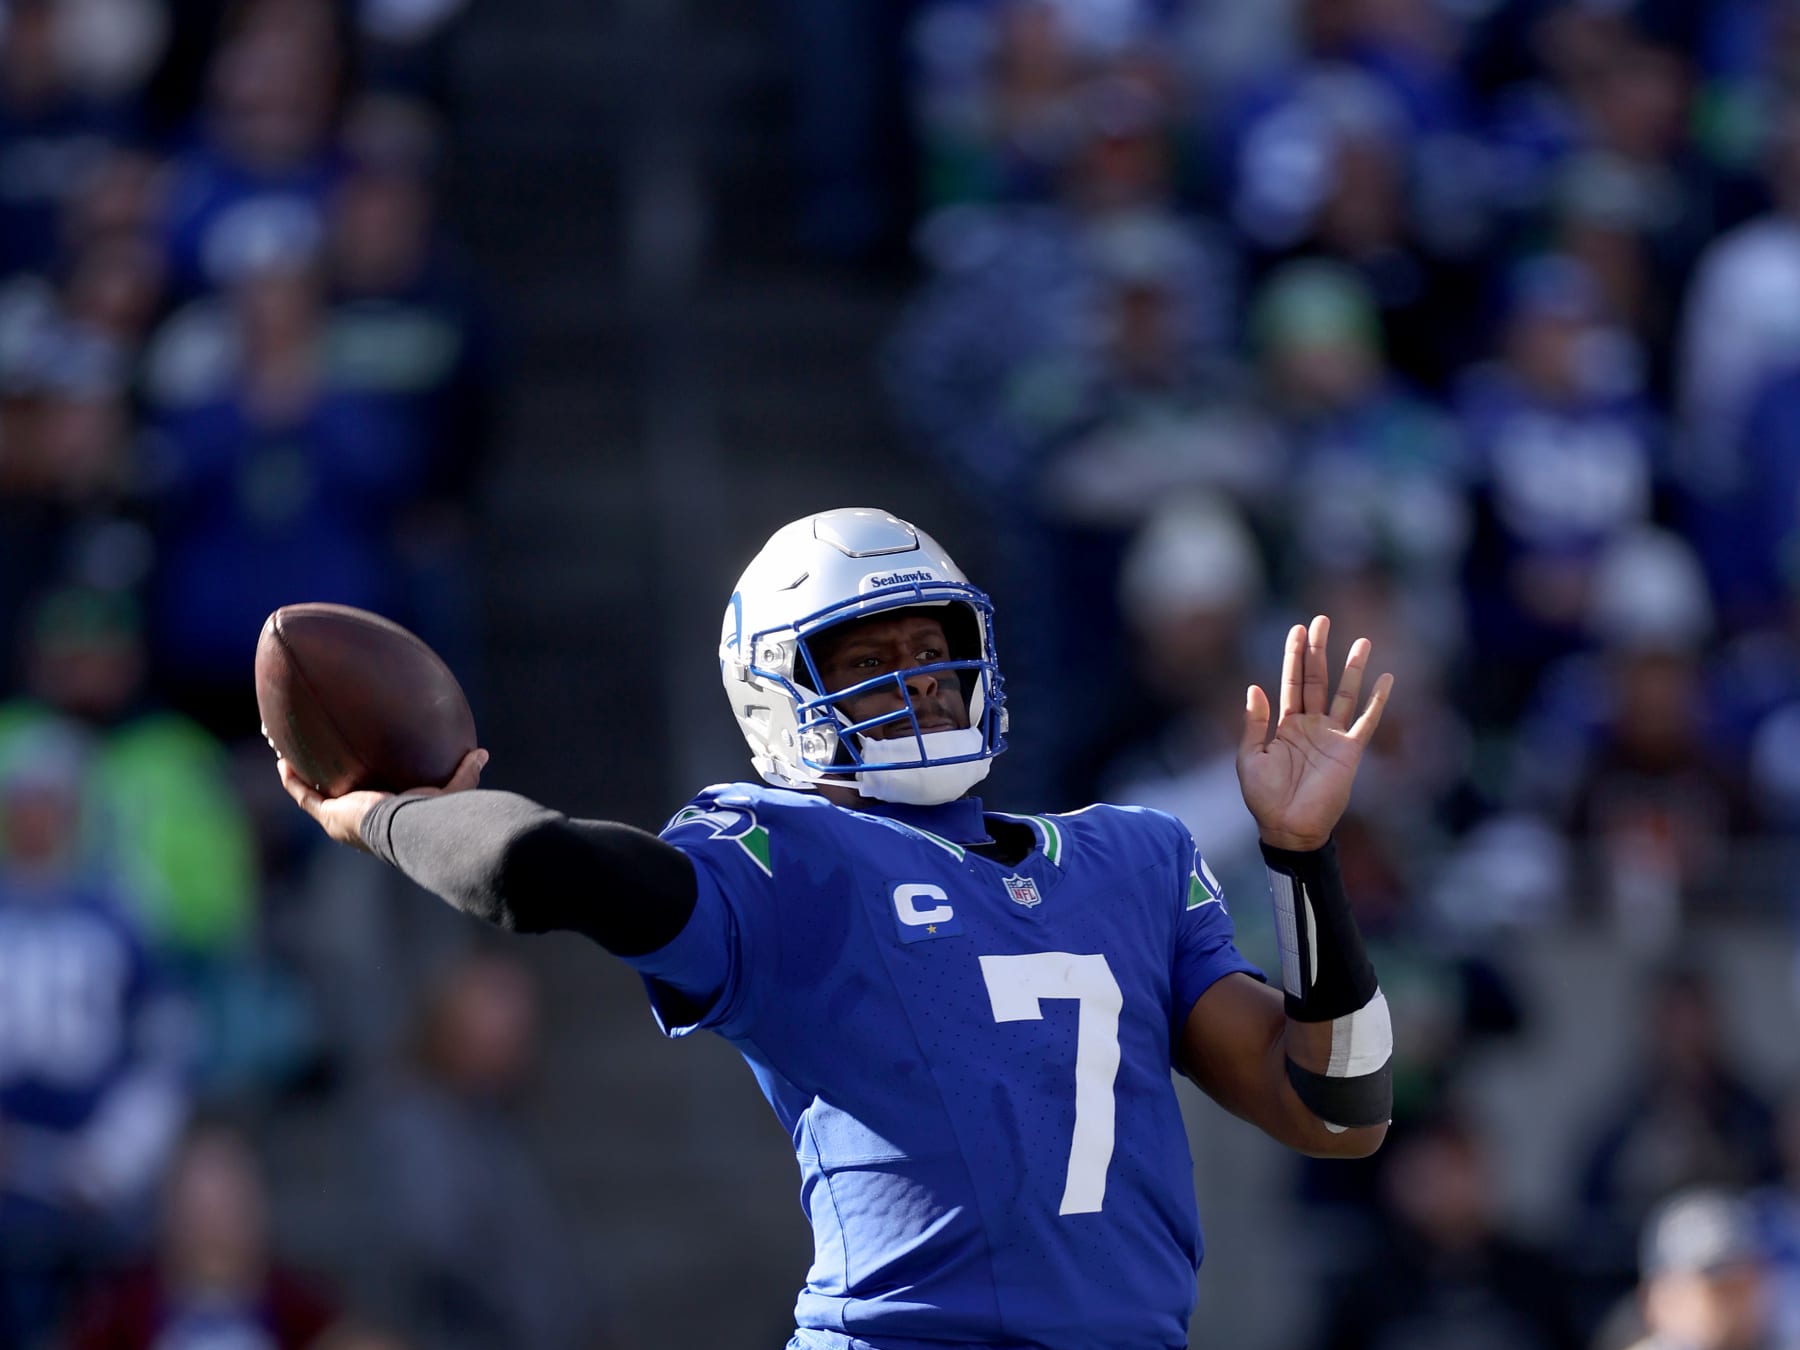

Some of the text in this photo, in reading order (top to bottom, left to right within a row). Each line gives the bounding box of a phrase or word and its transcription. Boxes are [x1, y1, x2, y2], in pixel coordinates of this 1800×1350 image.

[870, 570, 933, 588] Seahawks
[893, 883, 954, 927] C
[1013, 888, 1037, 901] NFL
[978, 951, 1124, 1216] 7
